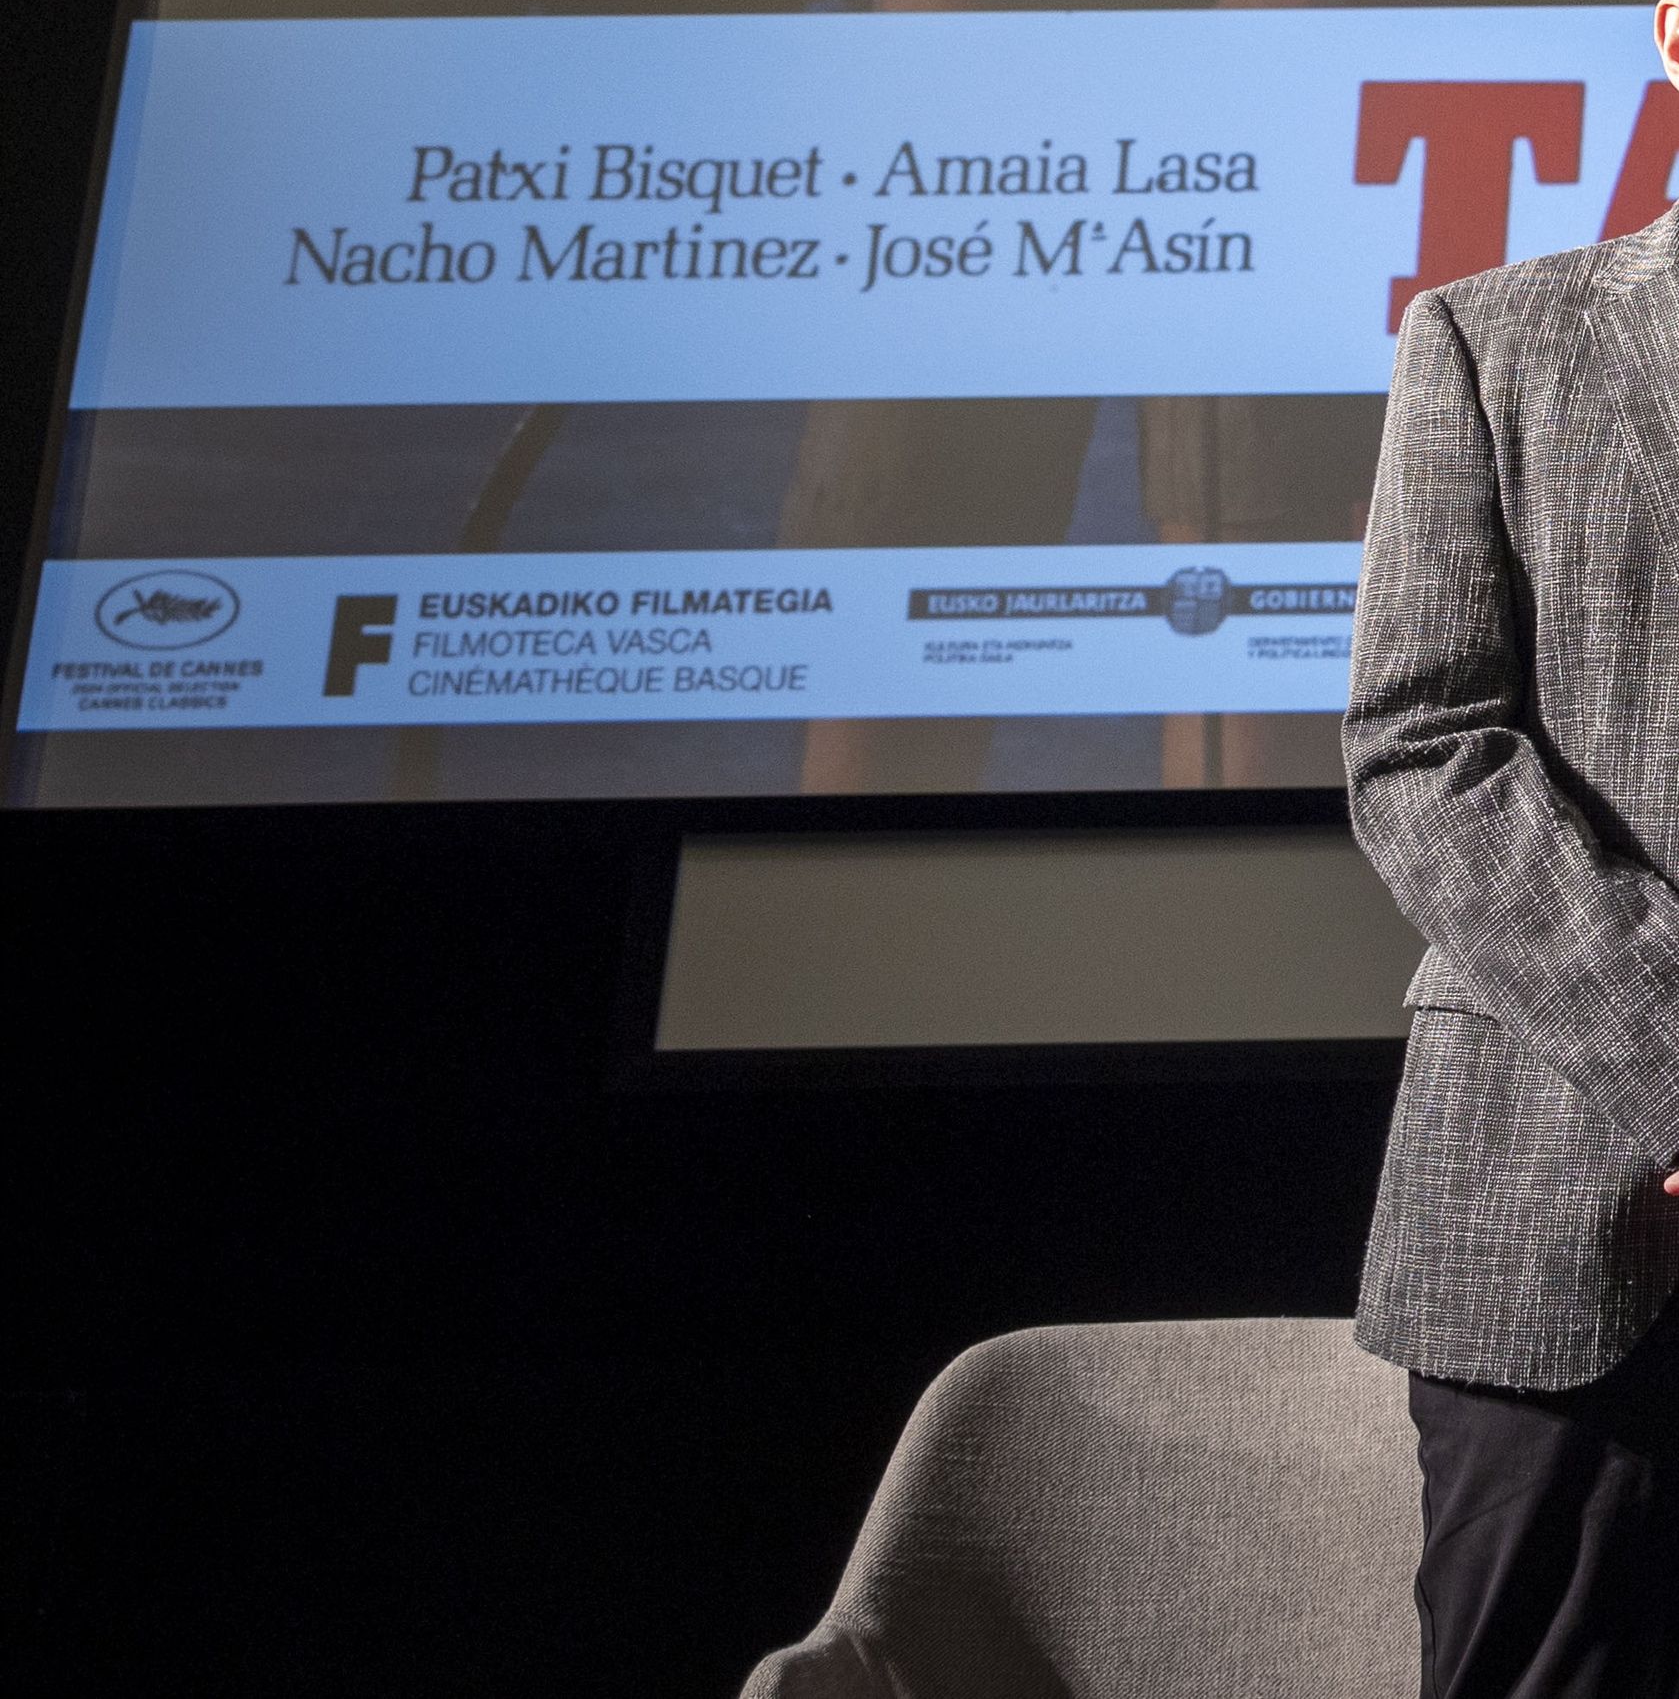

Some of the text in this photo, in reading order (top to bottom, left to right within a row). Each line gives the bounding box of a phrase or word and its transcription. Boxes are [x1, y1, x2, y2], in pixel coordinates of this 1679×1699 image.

[405, 138, 1260, 215] Patxi Bisquet Amaia Lasa
[282, 221, 498, 287] Nacho
[515, 221, 821, 284] Martinez
[860, 219, 994, 293] José
[1107, 216, 1255, 276] Asín
[418, 587, 834, 620] EUSKADIKO FILMATEGIA
[927, 591, 1149, 615] EUSKO JAURLARITZA
[1249, 589, 1356, 610] GOBIERN
[411, 627, 714, 659] FILMOTECA VASCA
[51, 658, 265, 681] FESTIVAL DE CANNES
[406, 663, 809, 698] CINÉMATHÈQUE BASQUE
